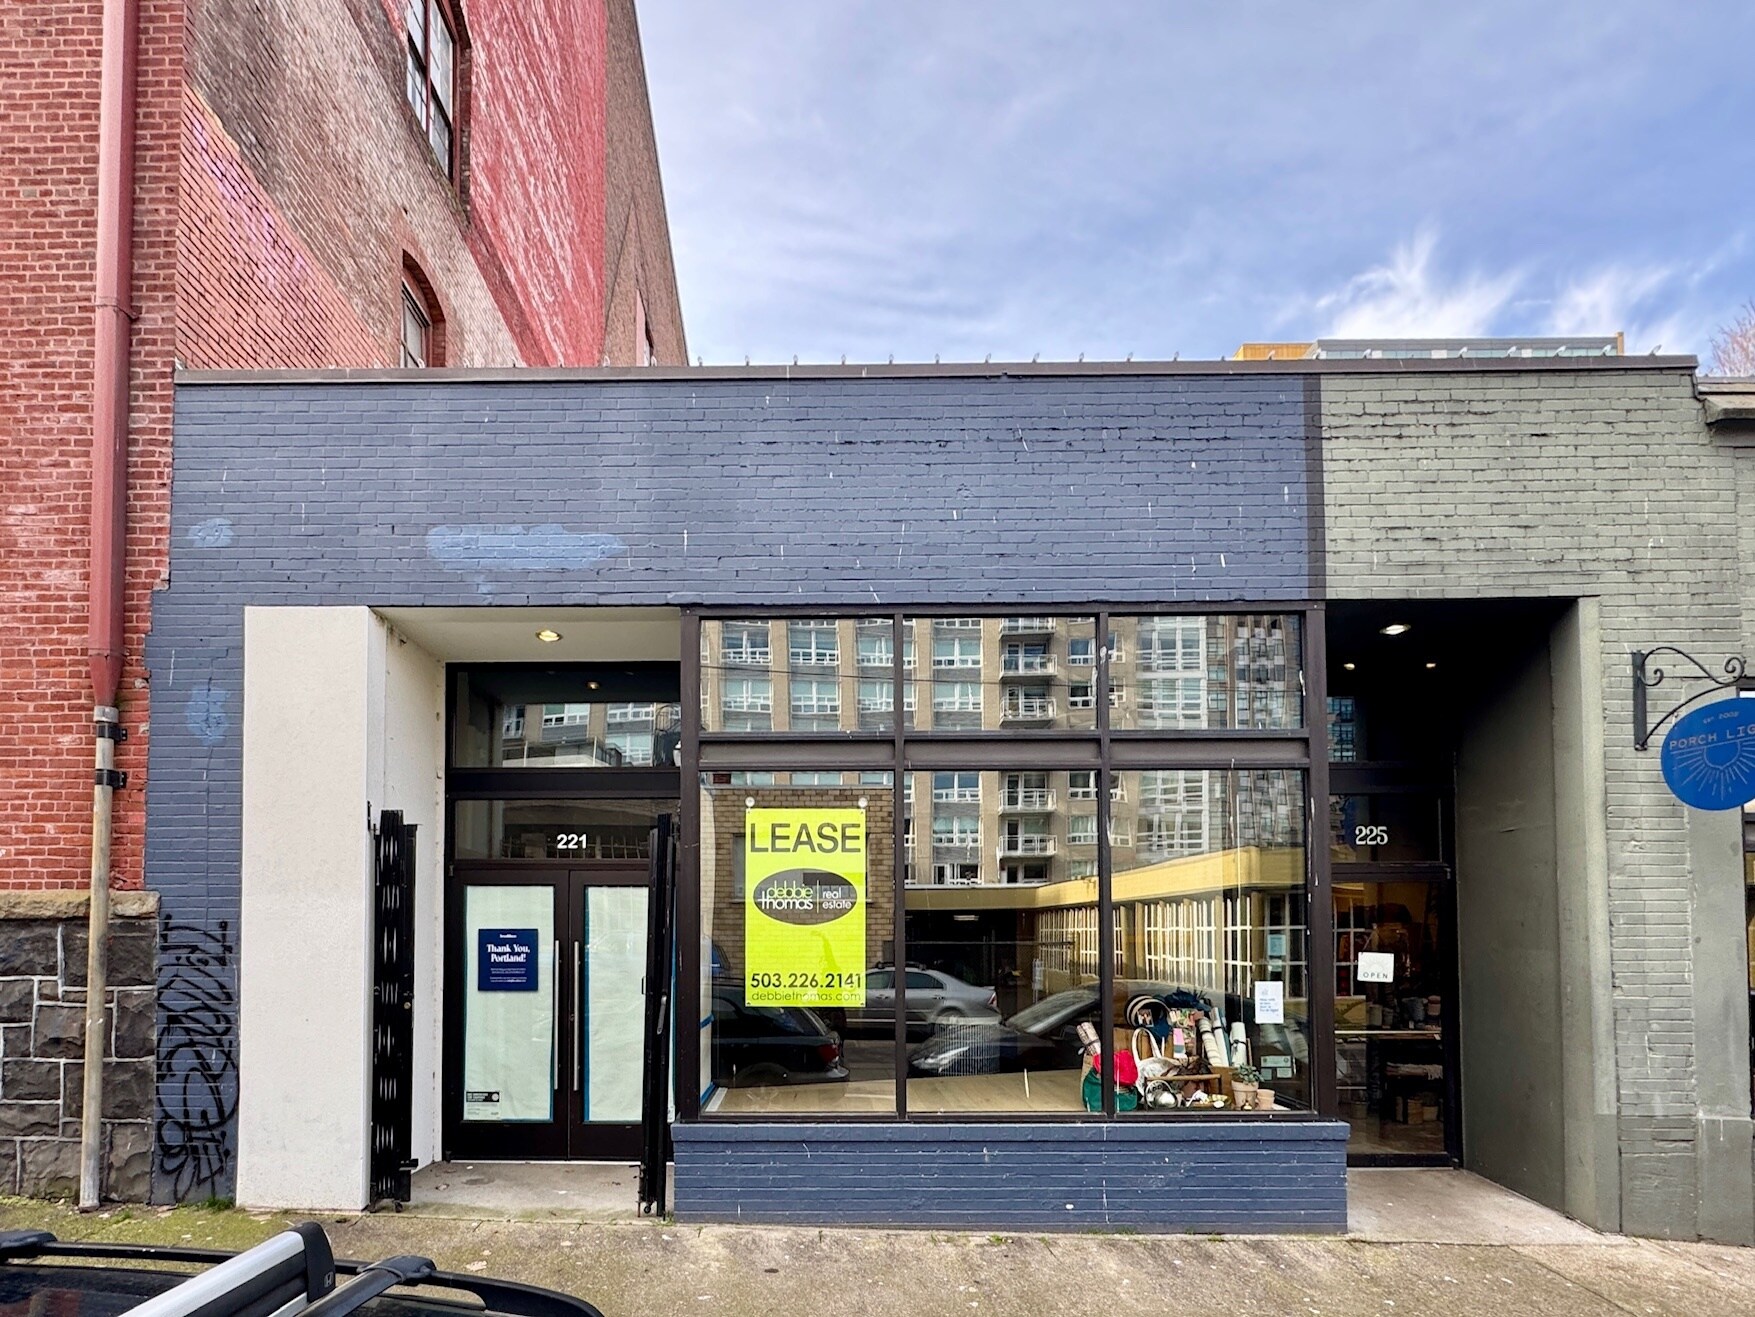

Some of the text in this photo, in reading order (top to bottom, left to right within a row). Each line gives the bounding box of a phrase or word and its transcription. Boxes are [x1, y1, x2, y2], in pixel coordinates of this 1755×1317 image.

[1669, 732, 1717, 750] PORCH
[557, 834, 587, 849] 221
[750, 822, 861, 854] LEASE
[1355, 825, 1388, 845] 225
[767, 880, 813, 898] debbie
[822, 886, 842, 899] real
[757, 890, 814, 910] thomas
[822, 900, 852, 910] estate
[486, 944, 512, 953] Thank
[490, 953, 527, 963] Portland!
[750, 973, 861, 988] 503.226.2141
[1363, 971, 1388, 980] OPEN
